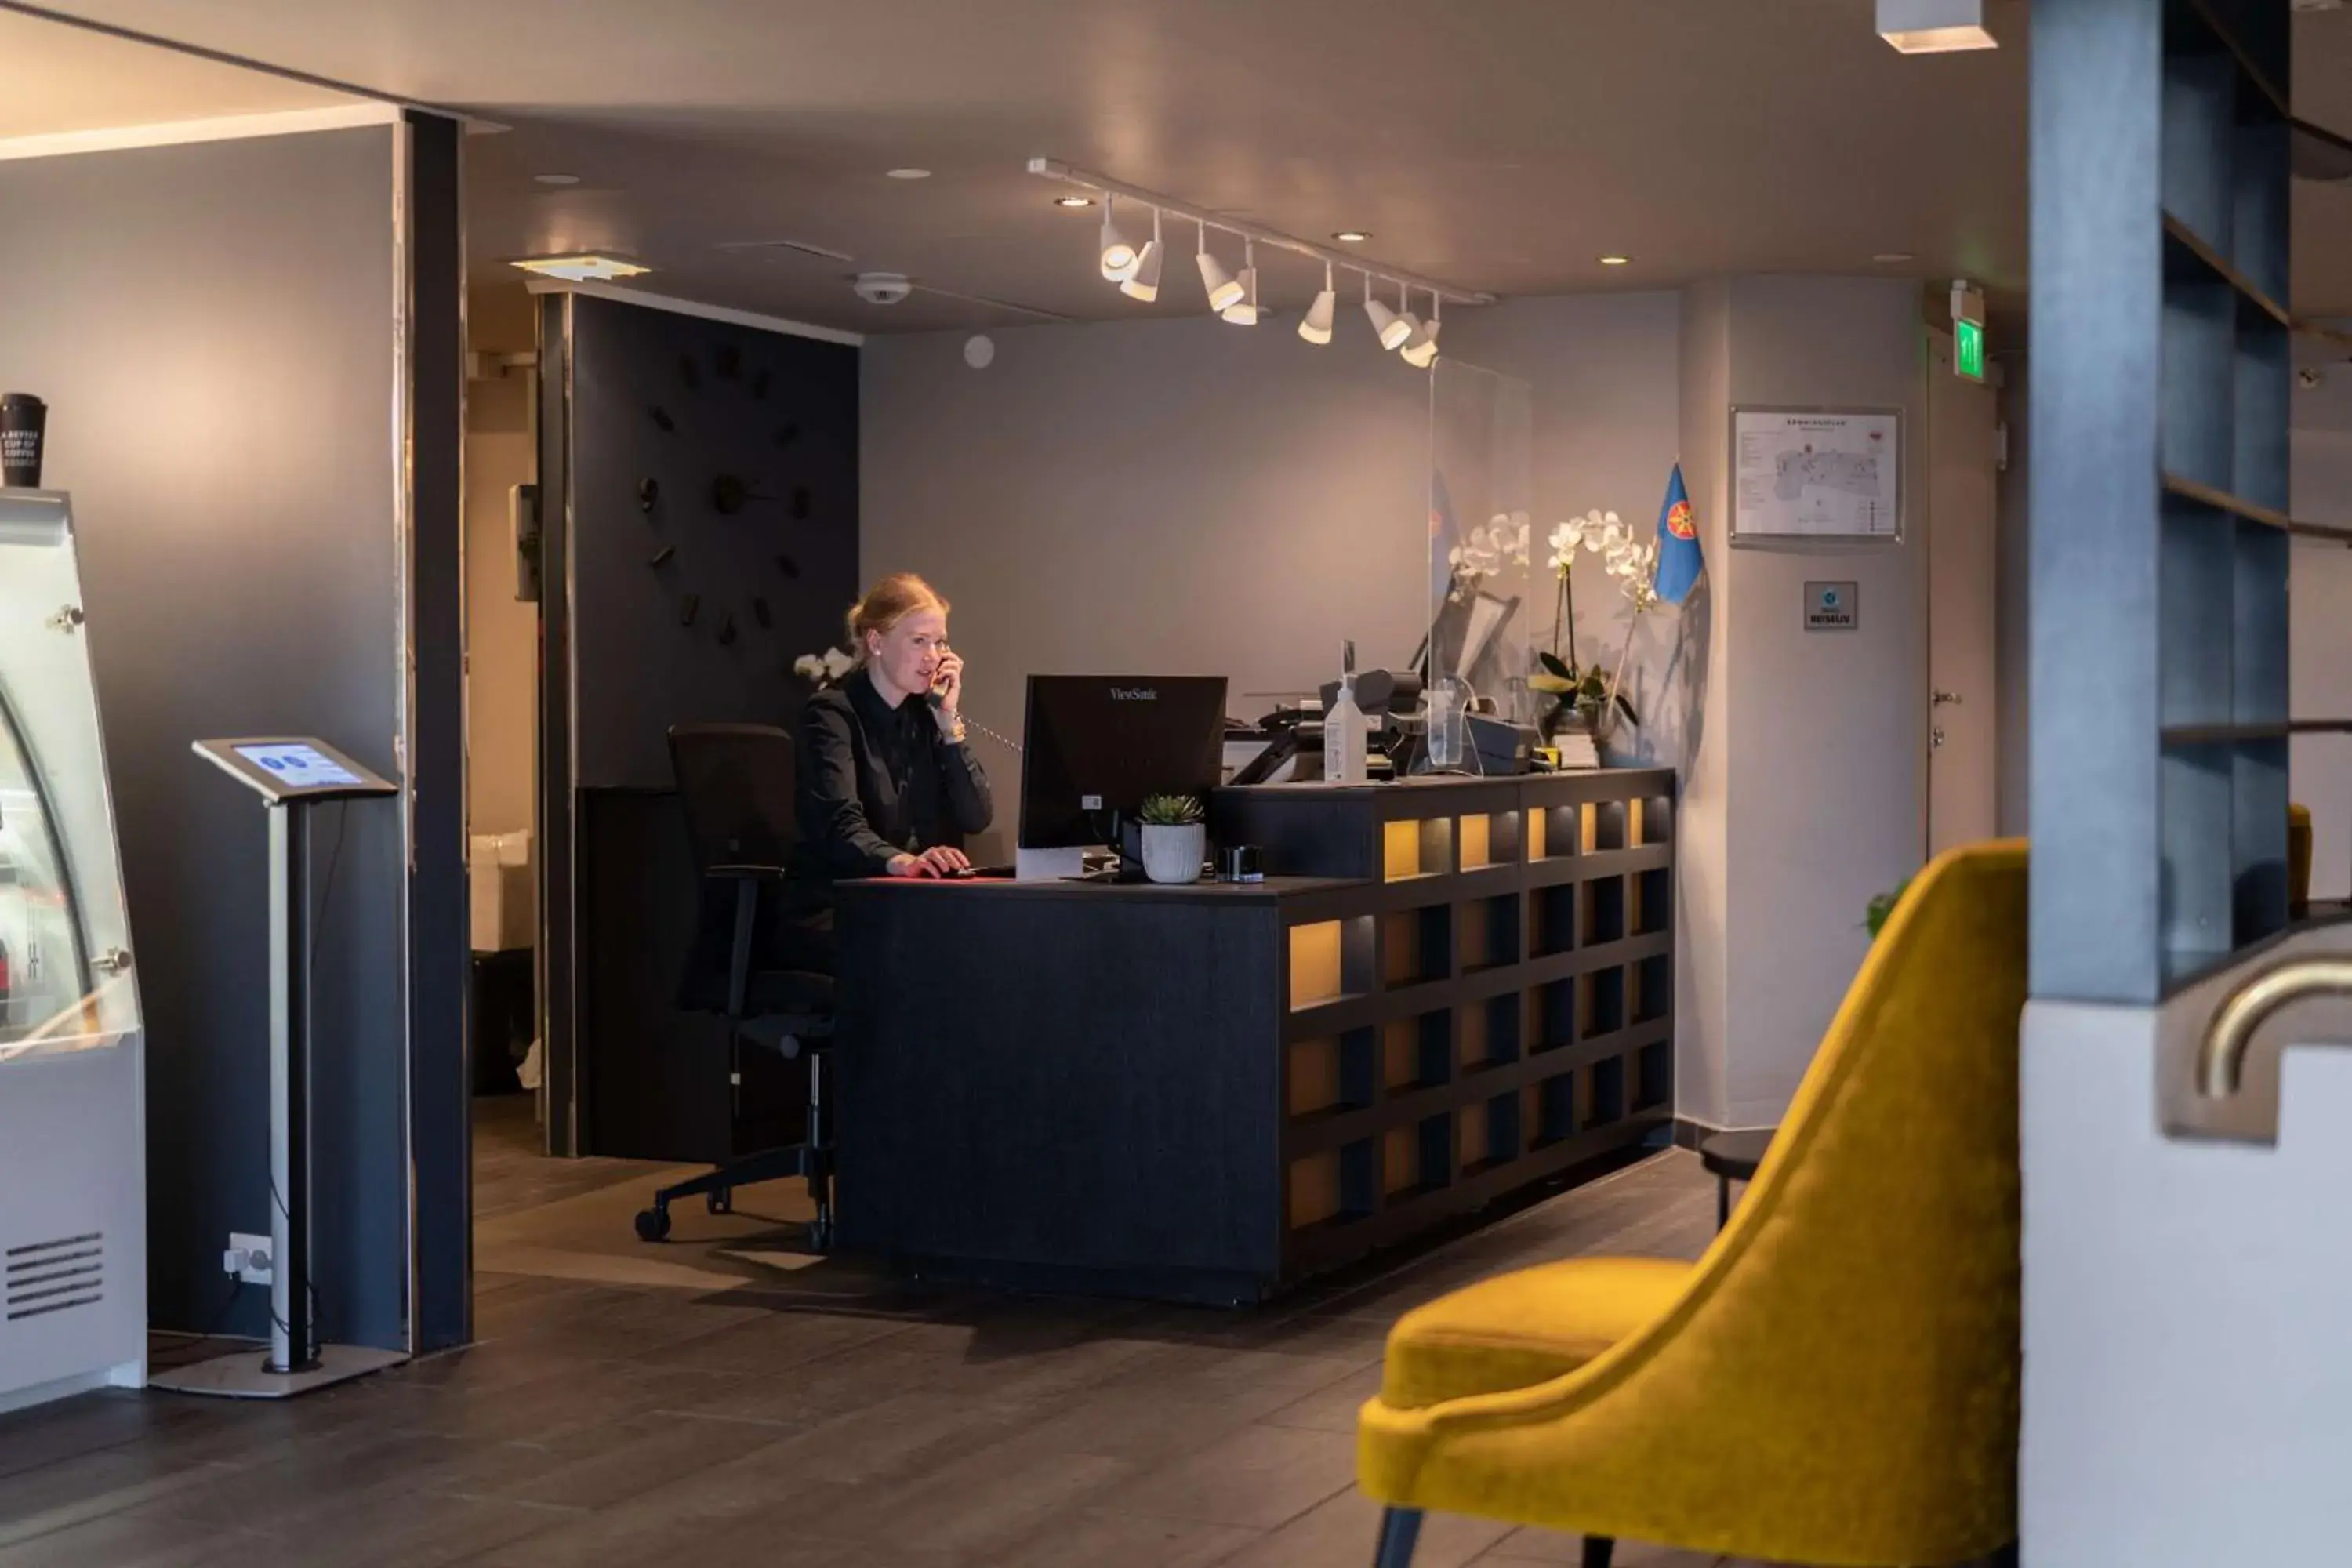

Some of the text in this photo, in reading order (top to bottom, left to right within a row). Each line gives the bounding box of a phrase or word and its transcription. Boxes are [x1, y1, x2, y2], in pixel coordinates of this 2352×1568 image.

[4, 440, 22, 448] CUP
[5, 449, 35, 458] COFFEE
[1110, 688, 1158, 700] ViewSonic
